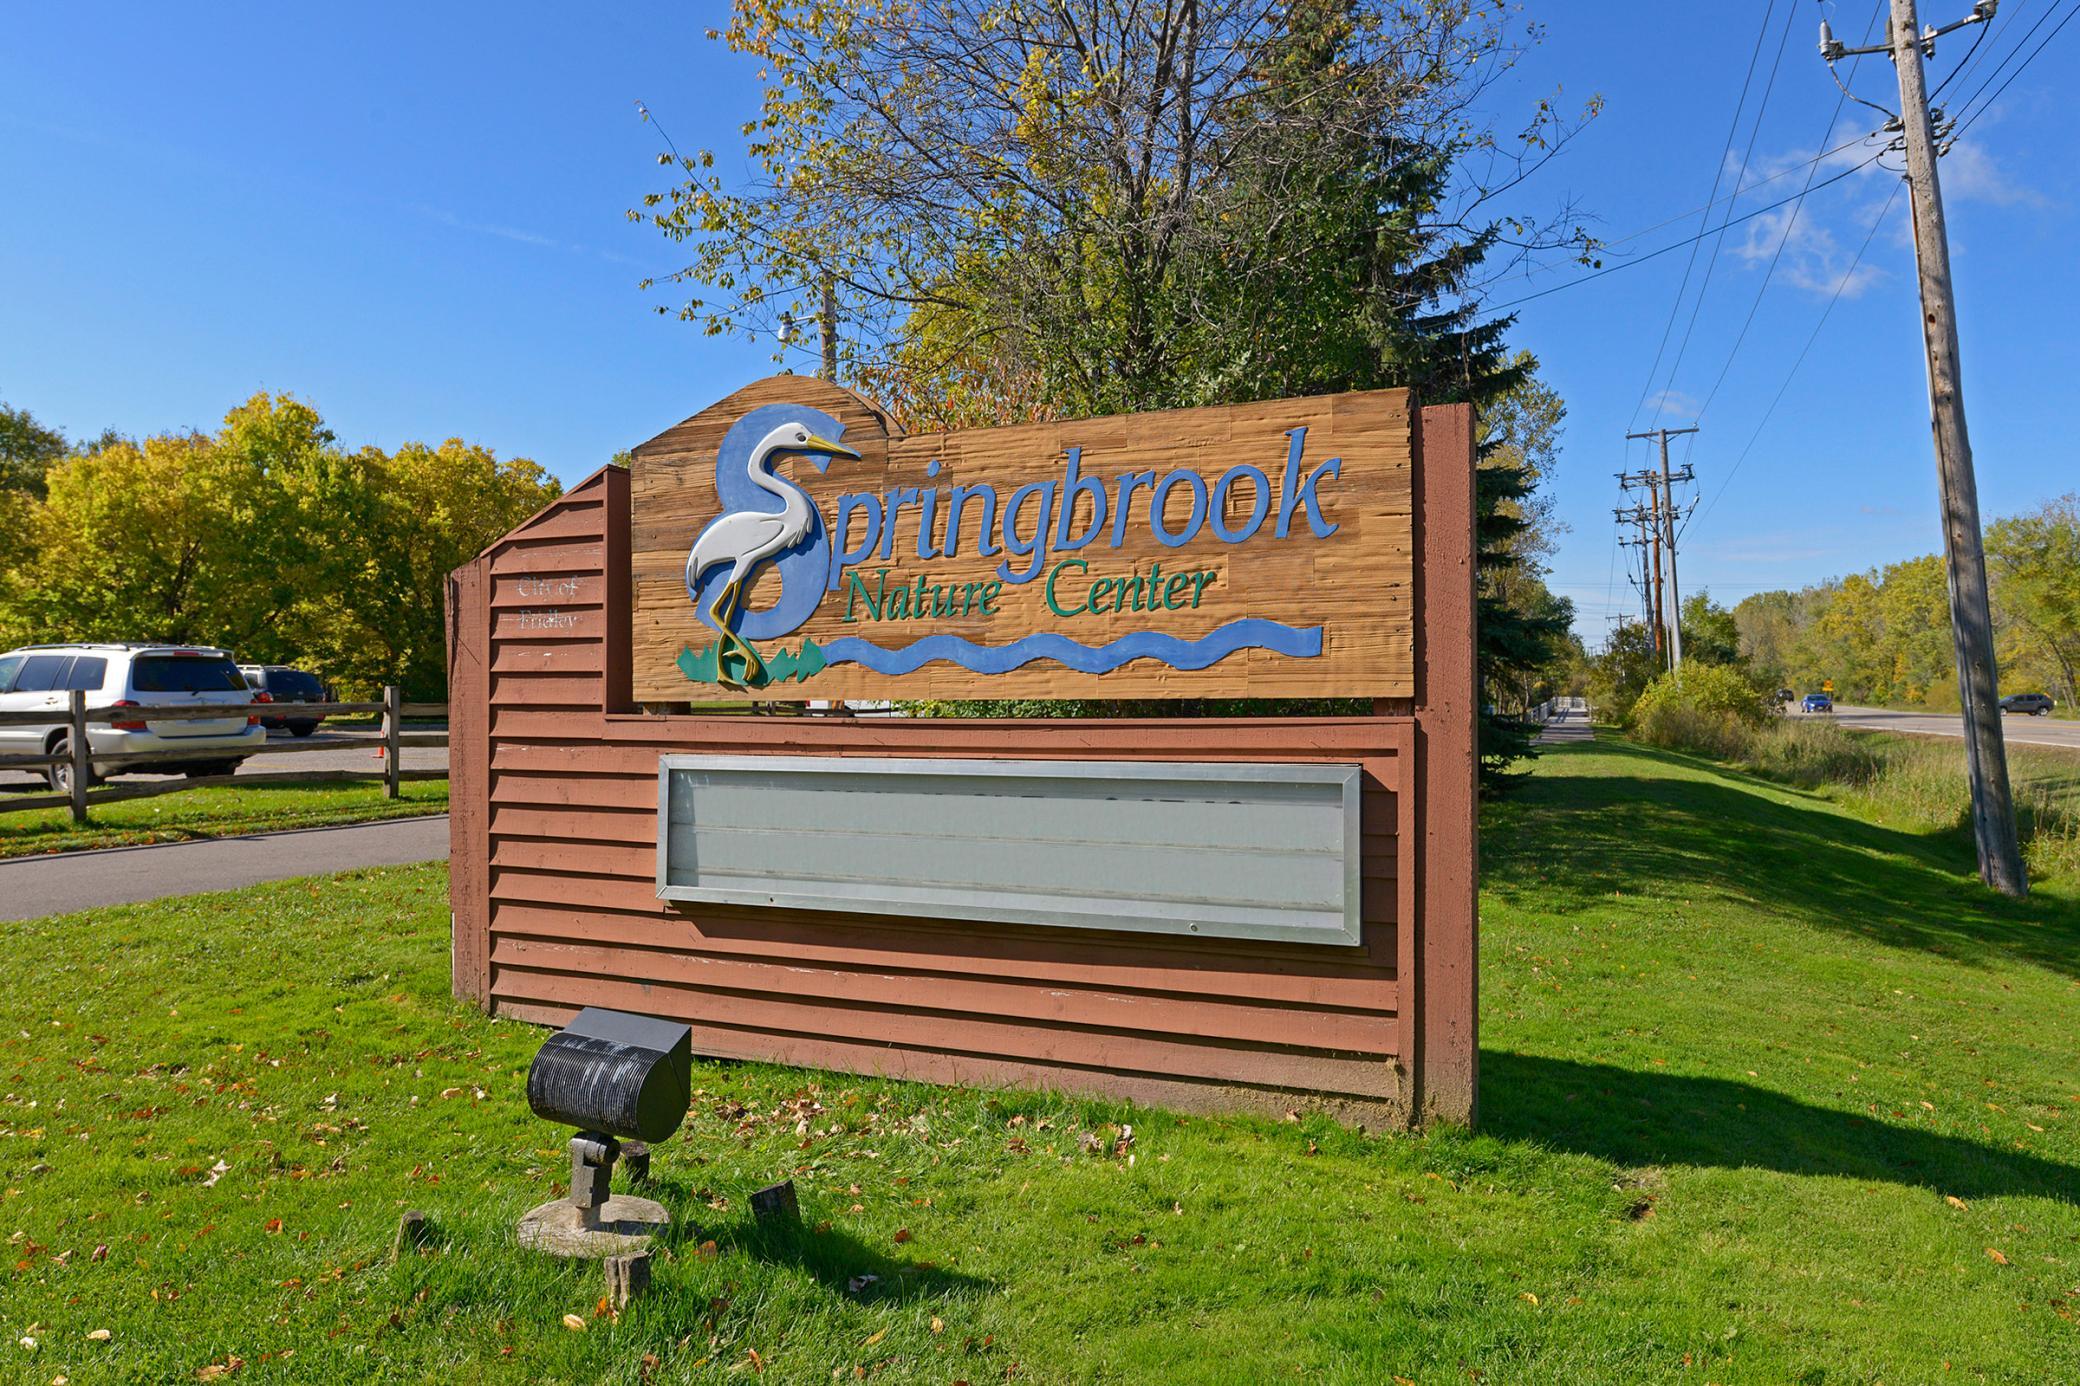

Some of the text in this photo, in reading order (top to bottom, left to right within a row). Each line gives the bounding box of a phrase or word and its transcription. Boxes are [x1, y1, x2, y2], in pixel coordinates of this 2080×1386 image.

[686, 404, 1342, 640] Springbrook
[843, 560, 1215, 623] Nature Center
